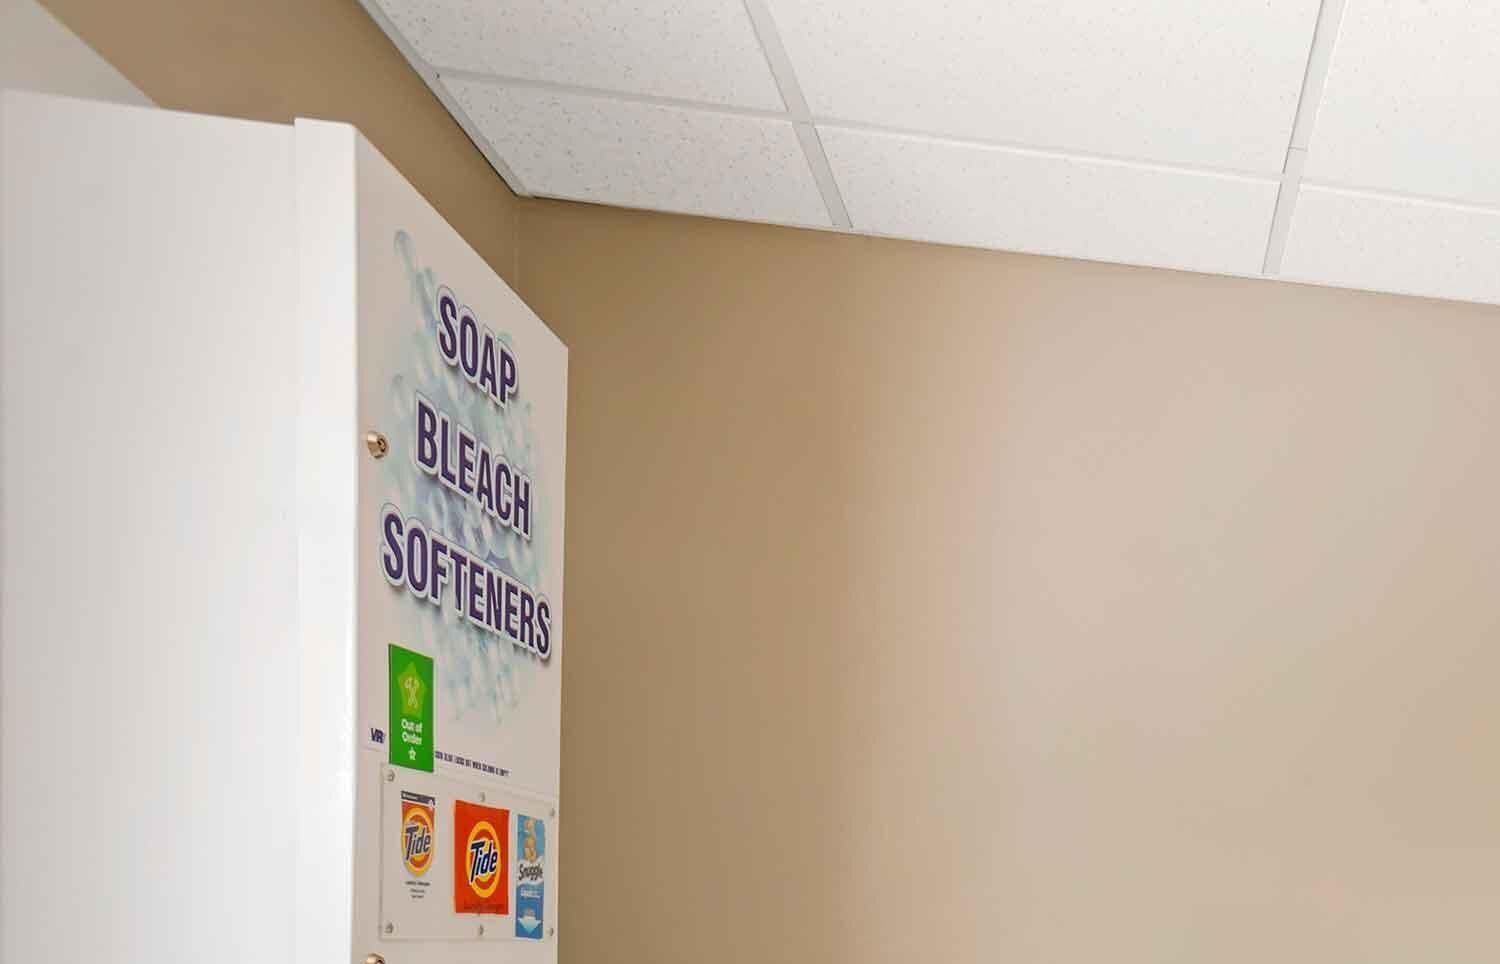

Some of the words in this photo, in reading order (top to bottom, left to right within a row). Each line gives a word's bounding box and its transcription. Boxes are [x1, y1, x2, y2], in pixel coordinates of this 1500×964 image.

[437, 293, 517, 403] SOAP
[417, 399, 531, 536] BLEACH
[383, 511, 551, 656] SOFTENERS
[405, 824, 432, 861] Tide
[470, 840, 498, 883] Tide
